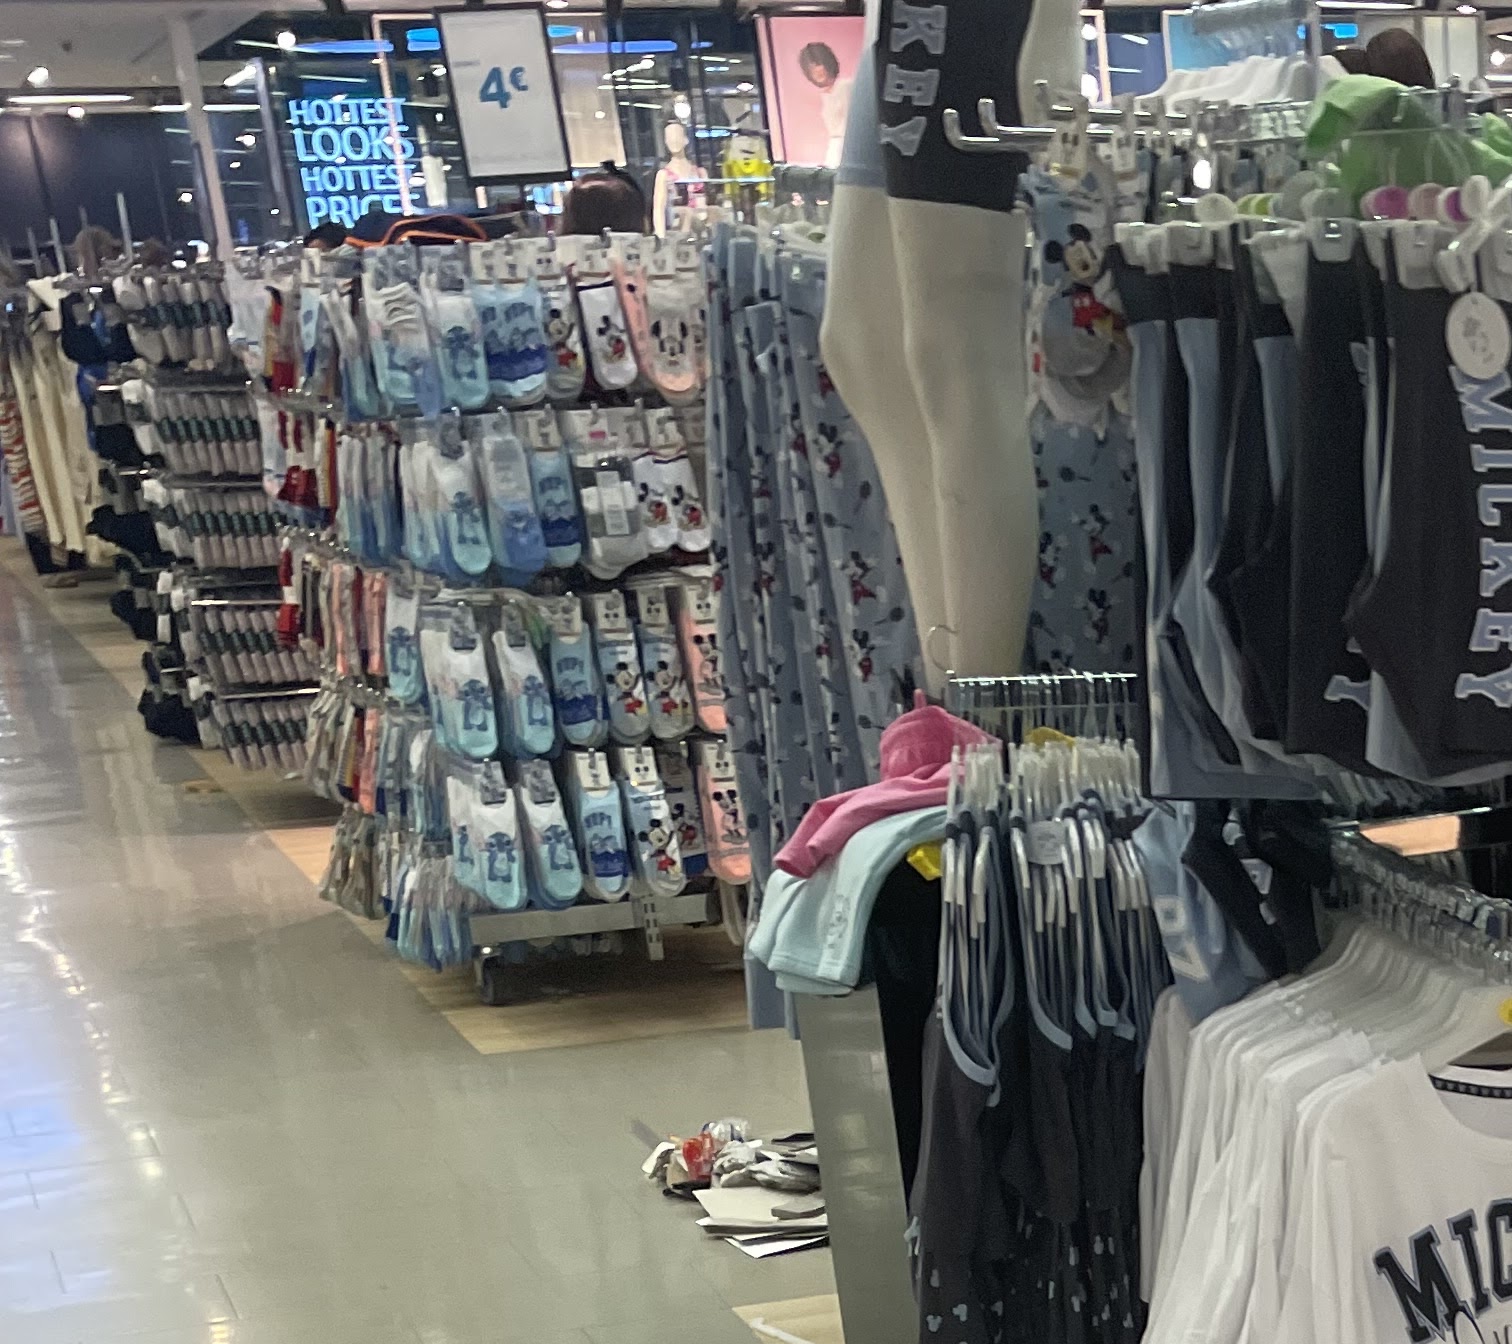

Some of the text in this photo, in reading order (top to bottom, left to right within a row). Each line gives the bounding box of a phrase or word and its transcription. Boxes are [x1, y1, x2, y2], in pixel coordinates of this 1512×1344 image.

[479, 66, 529, 109] 4€
[288, 97, 407, 126] HOTTEST
[292, 124, 416, 162] LOOKS
[299, 163, 418, 193] HOTTEST
